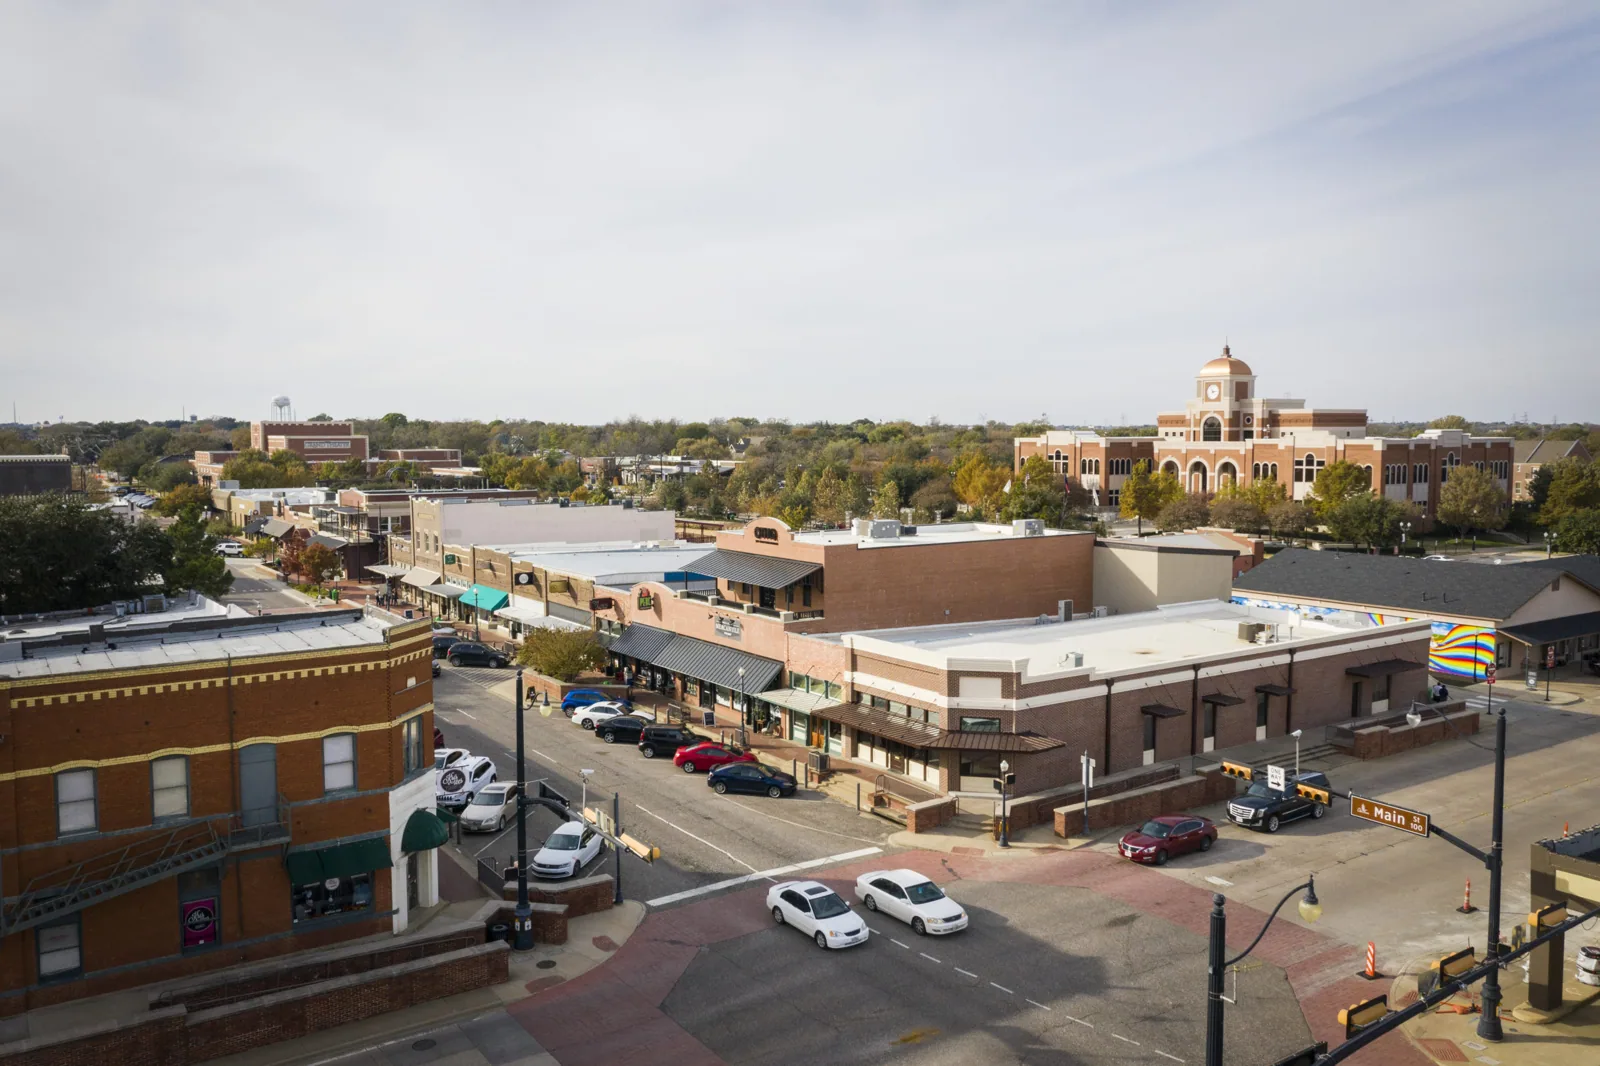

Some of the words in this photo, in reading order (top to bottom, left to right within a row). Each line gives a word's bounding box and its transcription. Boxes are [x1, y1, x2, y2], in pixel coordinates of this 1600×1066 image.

[1271, 767, 1281, 775] ONE
[1374, 806, 1405, 825] Main
[1413, 815, 1420, 823] St
[1410, 823, 1423, 831] 100
